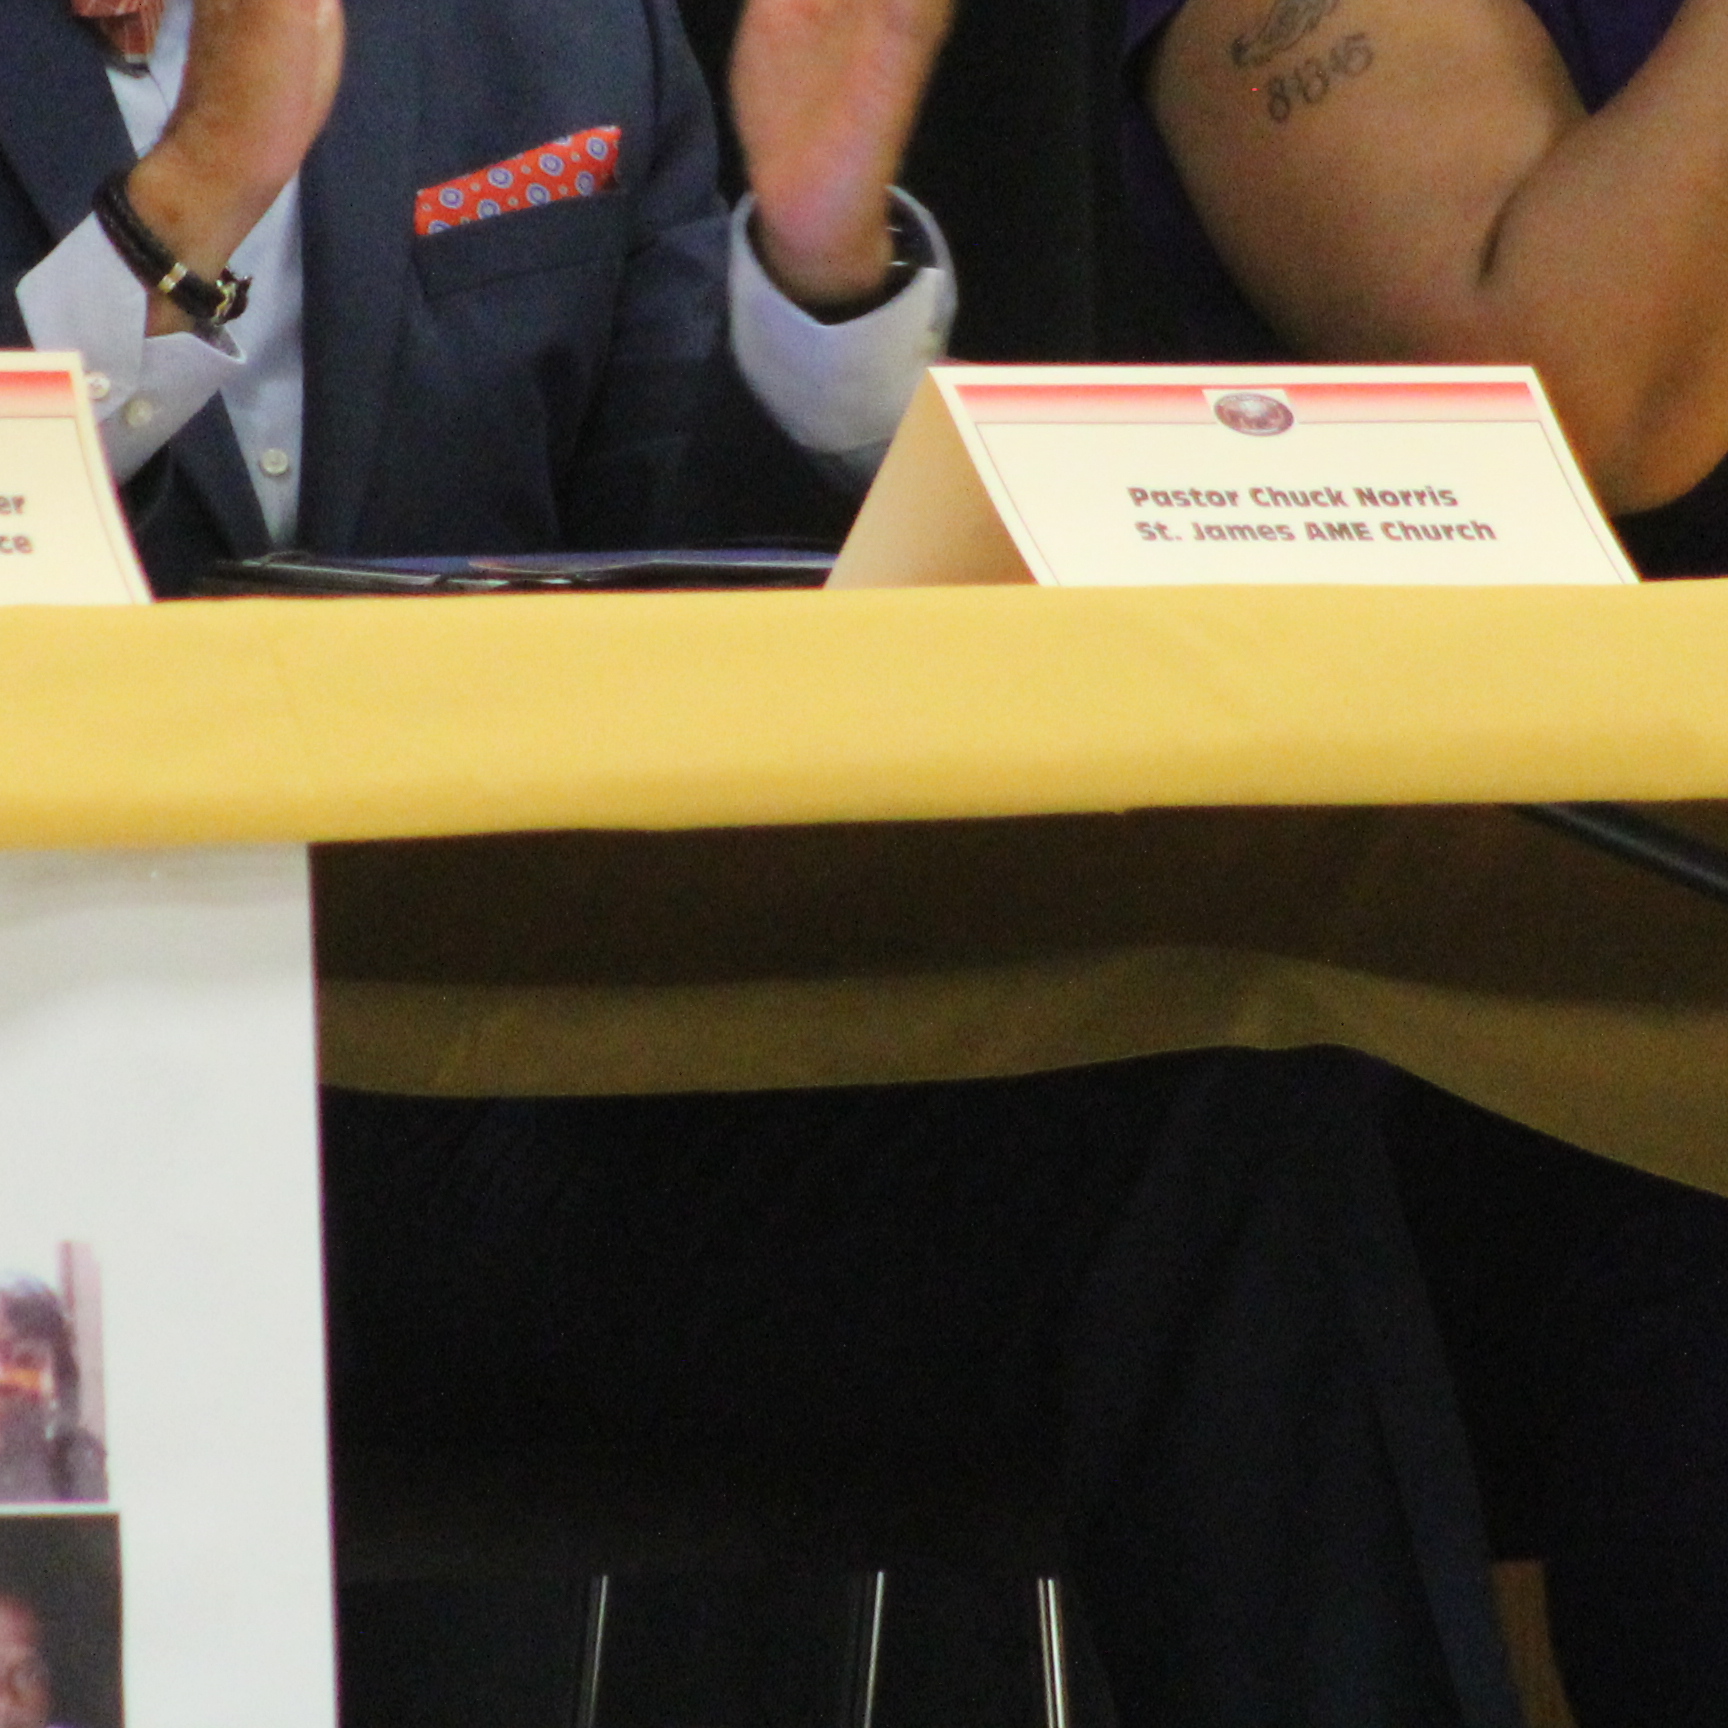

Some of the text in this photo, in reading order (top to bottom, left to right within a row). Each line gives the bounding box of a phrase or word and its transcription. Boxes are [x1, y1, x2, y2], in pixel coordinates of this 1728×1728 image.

[1127, 485, 1459, 508] Pastor Chuck Norris
[1134, 520, 1497, 542] St. James AME Church
